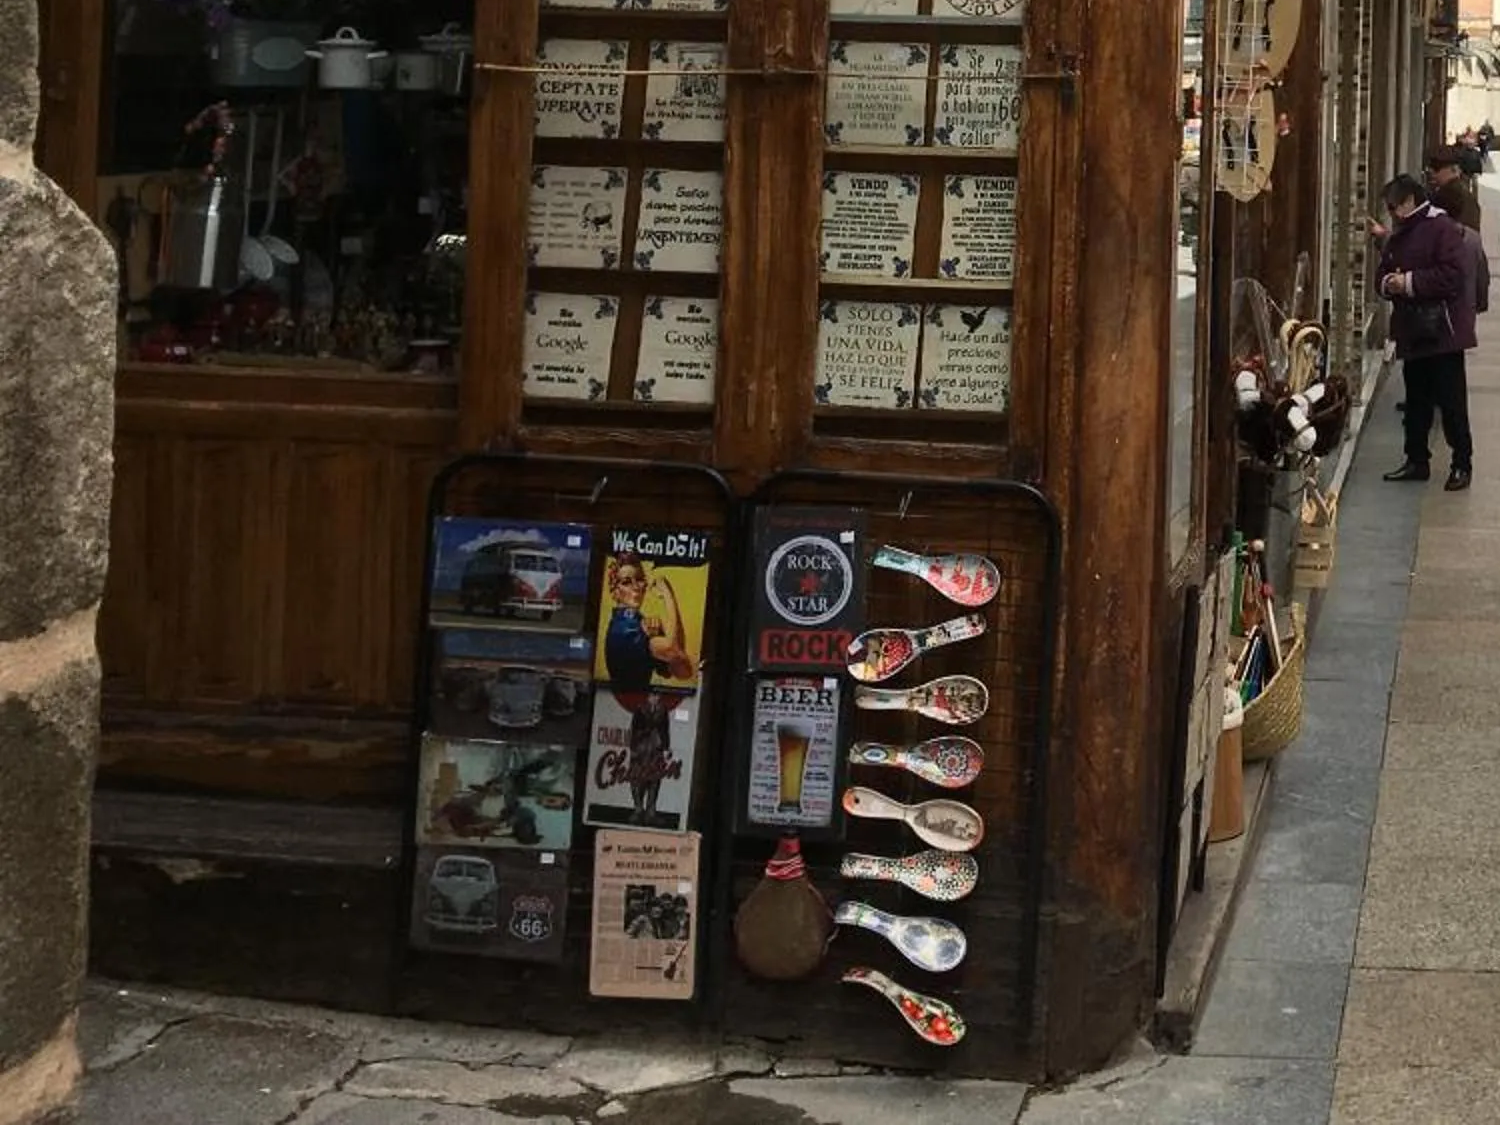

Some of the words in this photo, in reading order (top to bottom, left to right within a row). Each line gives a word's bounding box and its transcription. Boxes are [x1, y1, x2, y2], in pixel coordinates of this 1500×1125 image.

[850, 179, 889, 191] VENDO
[536, 333, 589, 356] Google
[613, 530, 635, 554] We
[636, 532, 663, 556] Can
[665, 535, 688, 557] Do
[688, 537, 707, 559] It!
[787, 554, 832, 572] ROCK
[787, 596, 829, 613] STAR
[767, 633, 846, 663] ROCK
[760, 687, 834, 706] BEER
[521, 918, 545, 937] 66
